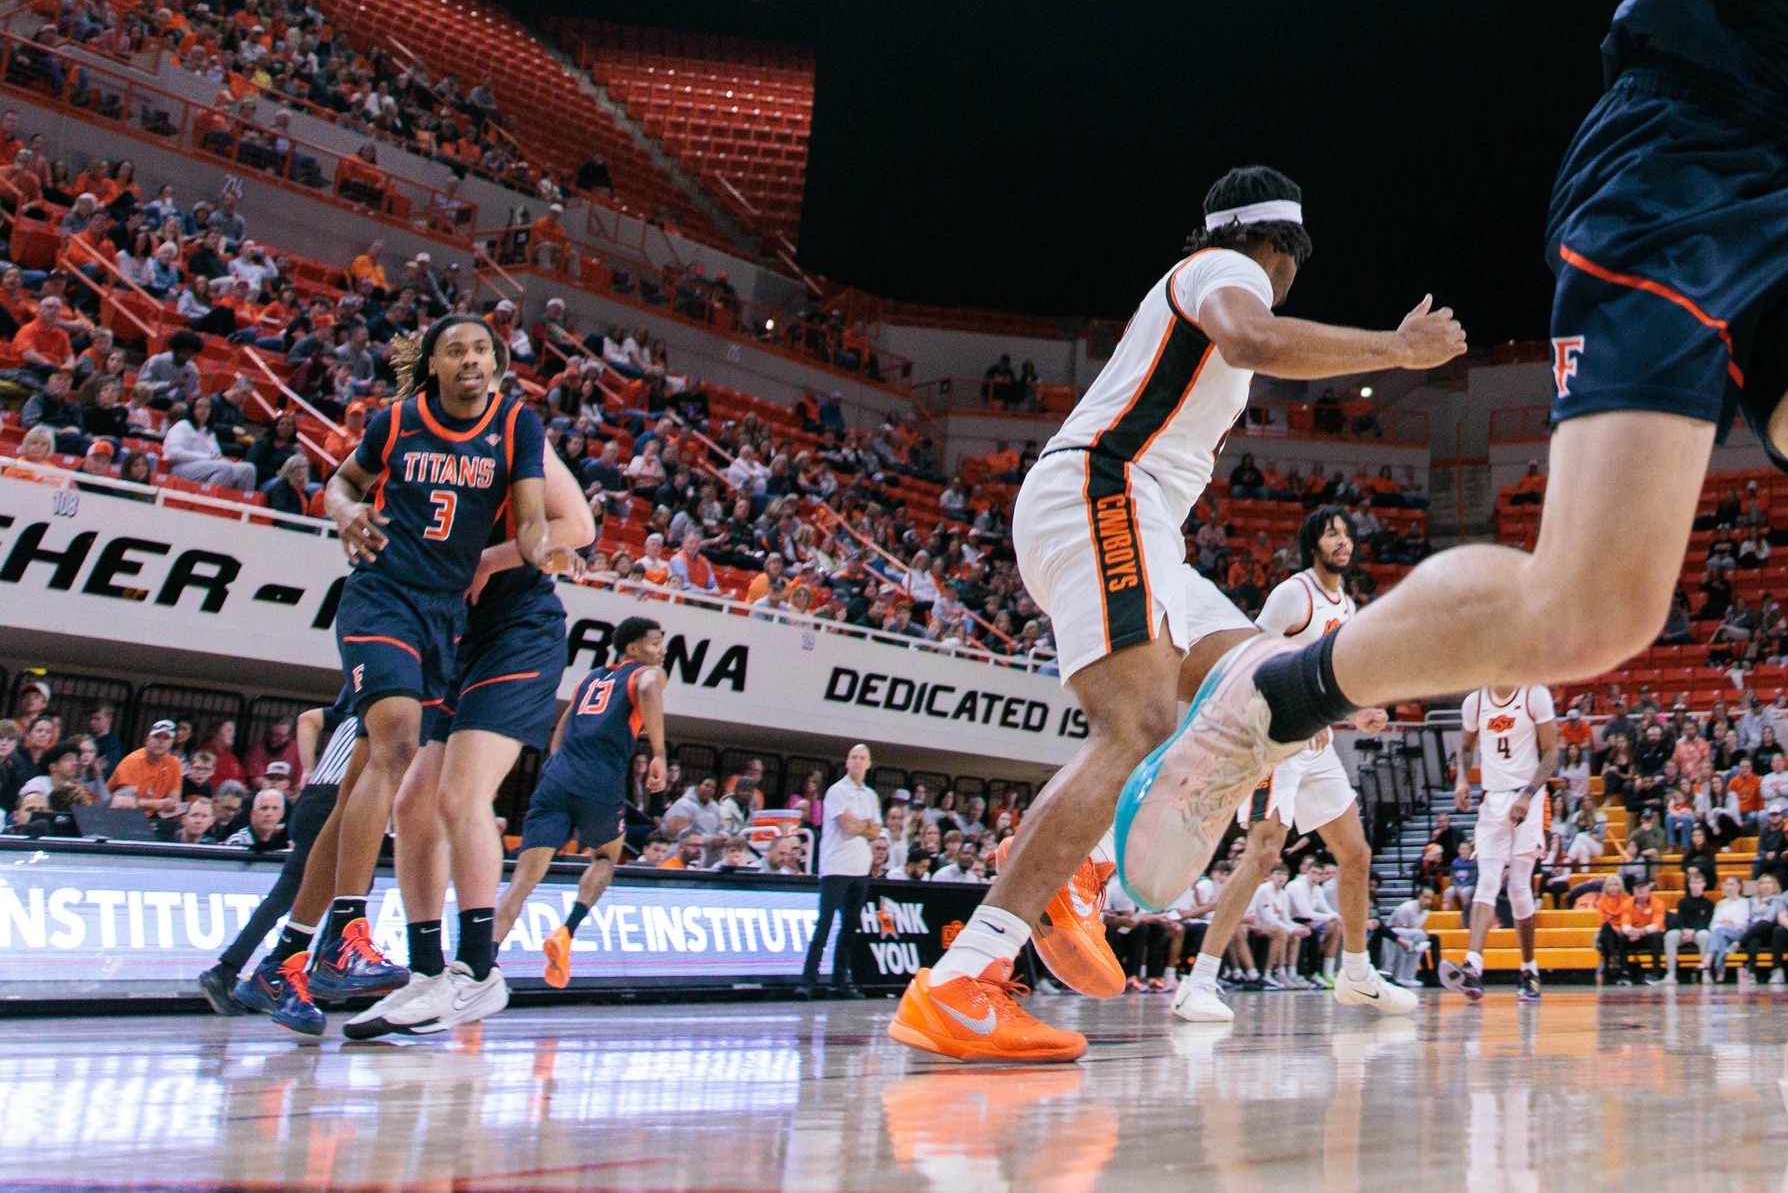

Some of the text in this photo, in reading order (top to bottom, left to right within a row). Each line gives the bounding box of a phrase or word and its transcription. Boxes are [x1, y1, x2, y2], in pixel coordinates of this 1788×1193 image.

[1551, 334, 1585, 400] F
[403, 451, 496, 489] TITANS
[422, 489, 458, 542] 3
[1096, 493, 1140, 593] COWBOYS
[577, 678, 616, 715] 13
[823, 665, 1091, 739] DEDICATED IS
[1496, 737, 1512, 760] 4
[869, 942, 921, 975] YOU
